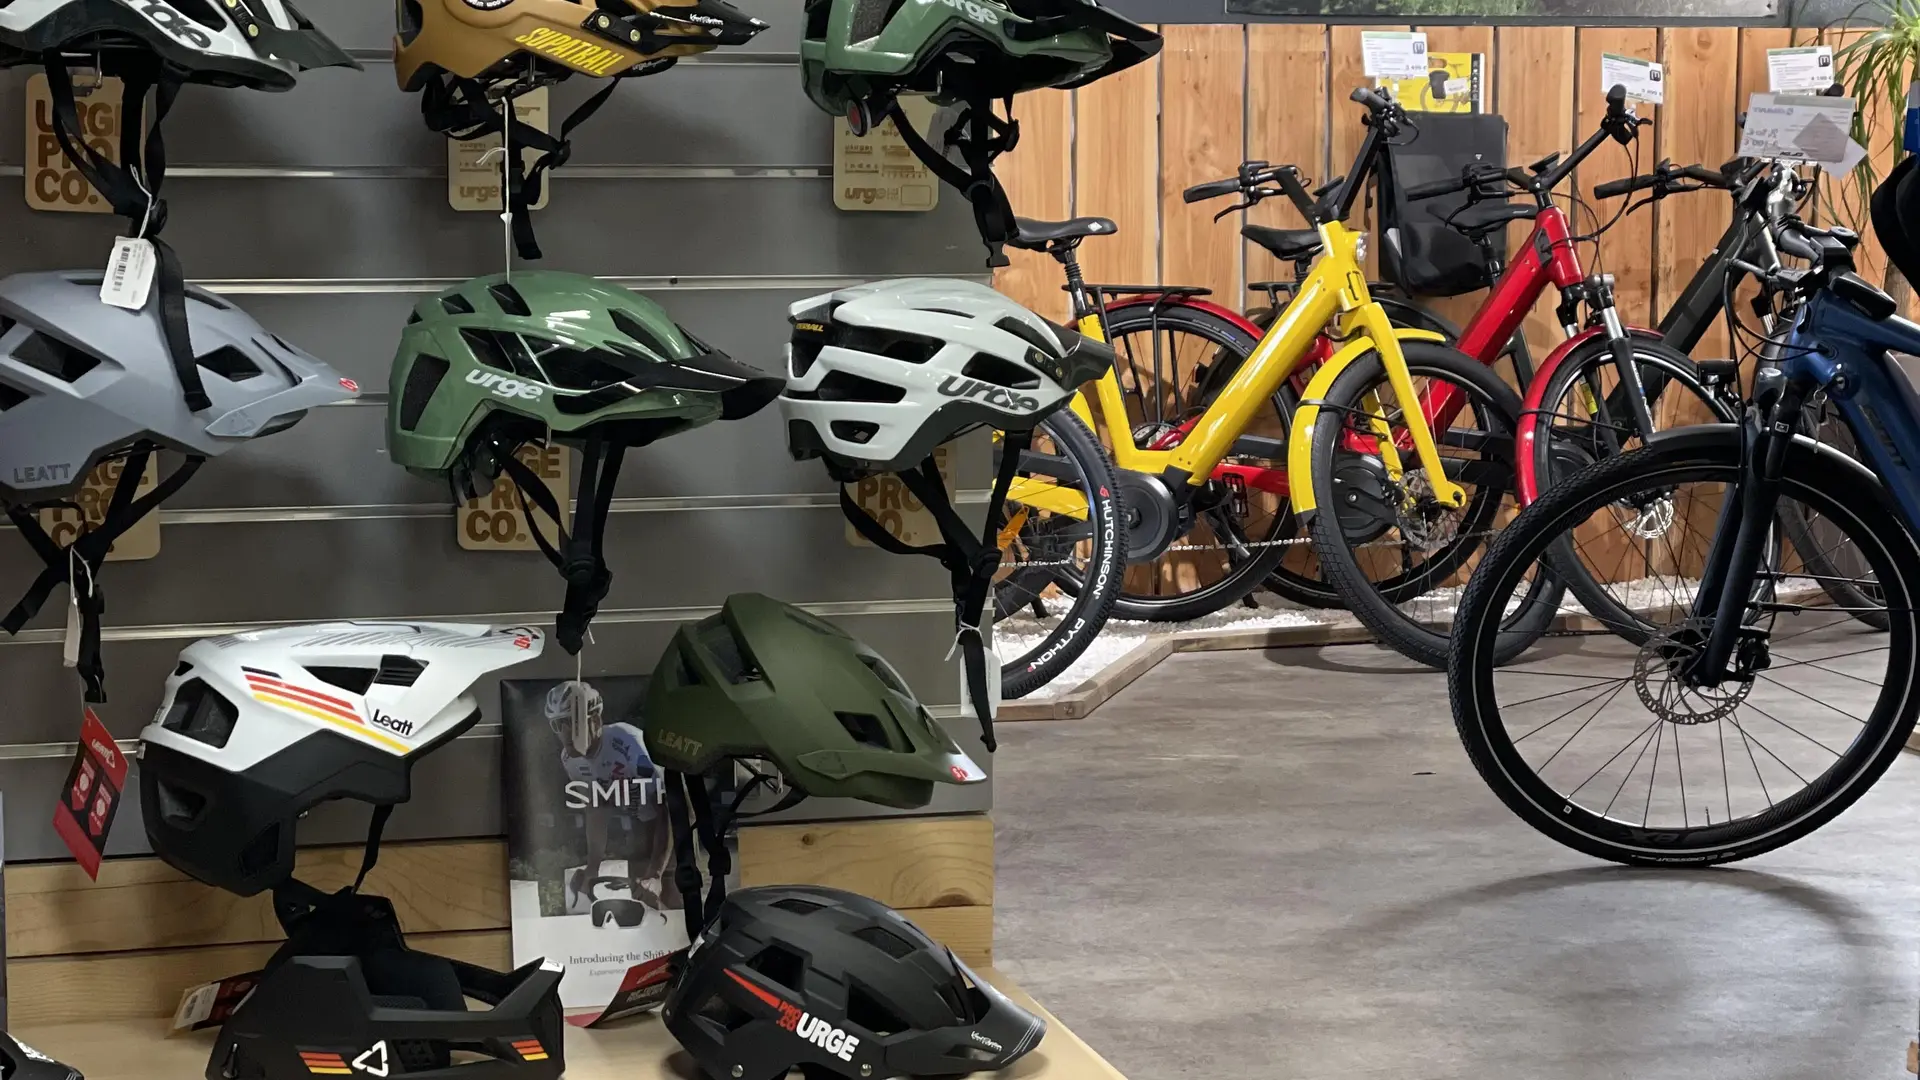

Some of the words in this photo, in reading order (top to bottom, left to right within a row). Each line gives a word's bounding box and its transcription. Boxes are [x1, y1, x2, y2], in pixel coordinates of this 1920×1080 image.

[35, 168, 99, 205] CO.
[845, 187, 886, 204] urge
[465, 369, 543, 399] urge
[13, 463, 71, 483] LEATT
[466, 510, 527, 543] CO.
[1093, 500, 1114, 595] HUTCHINSON
[1031, 617, 1085, 670] PYTHON
[373, 708, 412, 736] Leatt
[657, 728, 702, 757] LEATT
[569, 952, 625, 965] Introducing
[626, 951, 641, 961] the
[778, 1001, 803, 1020] PRO
[796, 1012, 860, 1062] URGE
